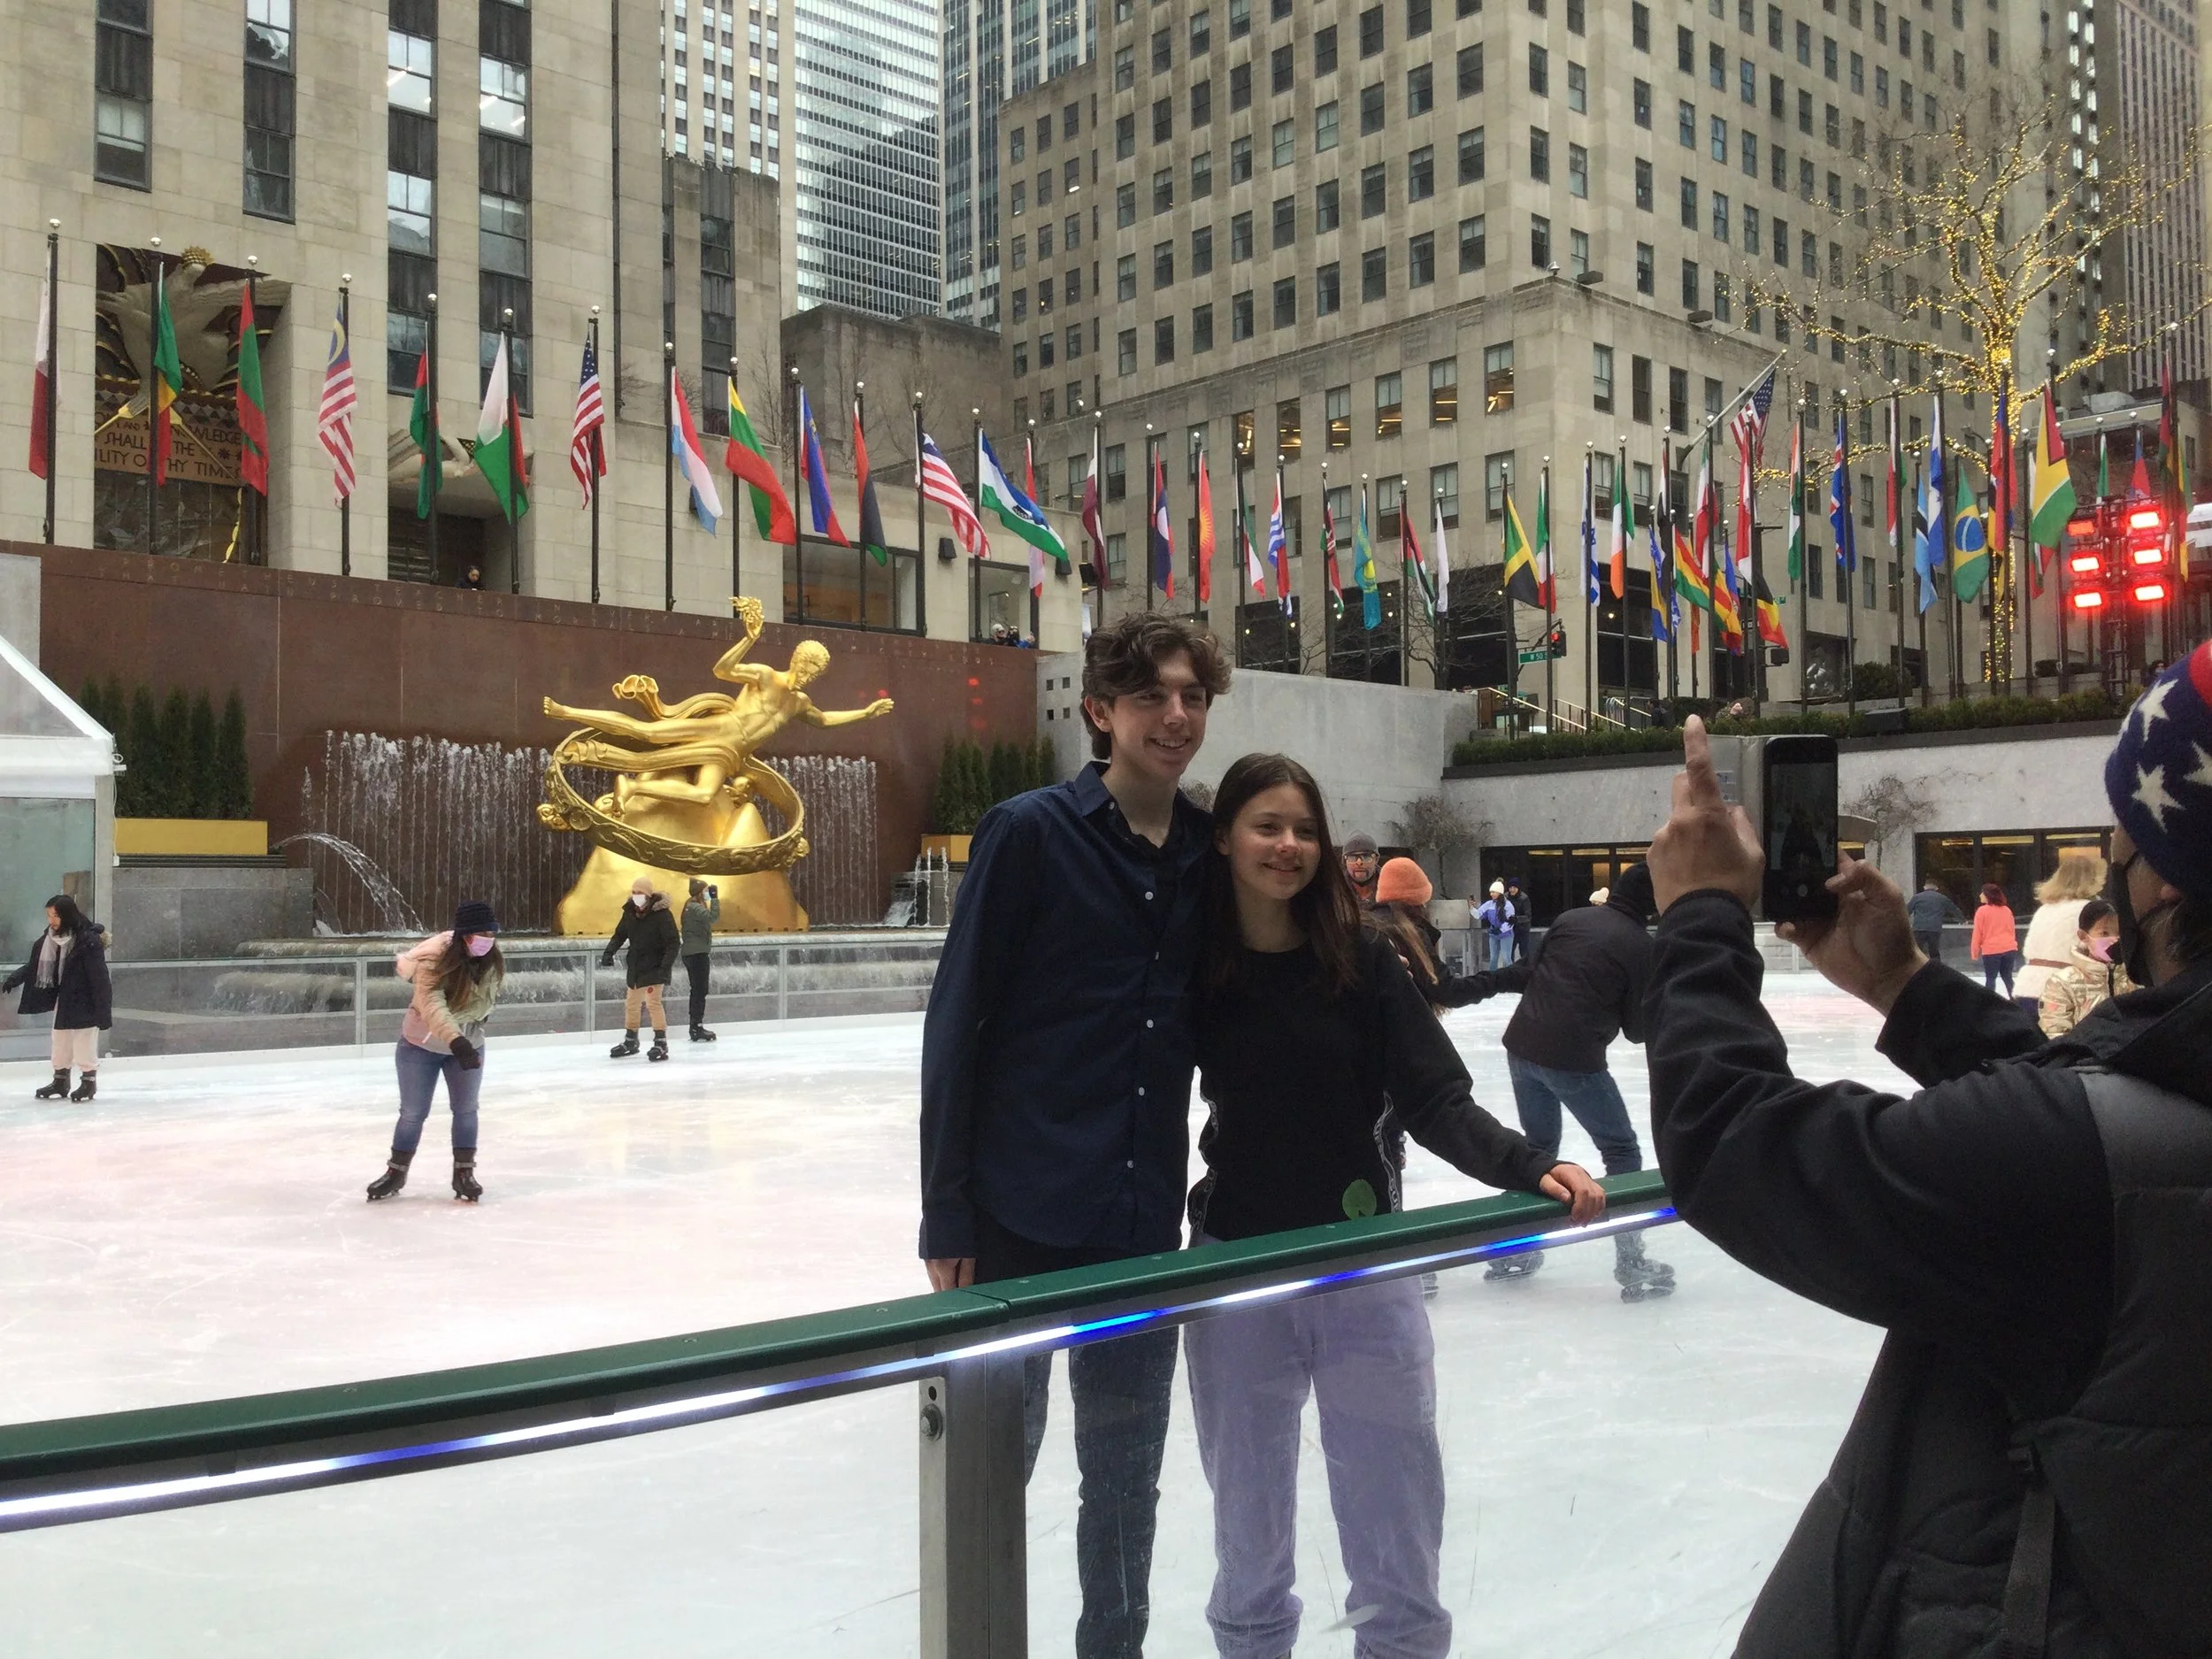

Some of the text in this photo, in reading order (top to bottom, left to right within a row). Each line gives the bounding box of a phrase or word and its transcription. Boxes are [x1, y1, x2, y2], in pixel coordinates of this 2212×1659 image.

[104, 432, 195, 457] SHALL THE
[95, 448, 130, 465] ILITY
[133, 453, 148, 467] O
[166, 457, 188, 472] HY
